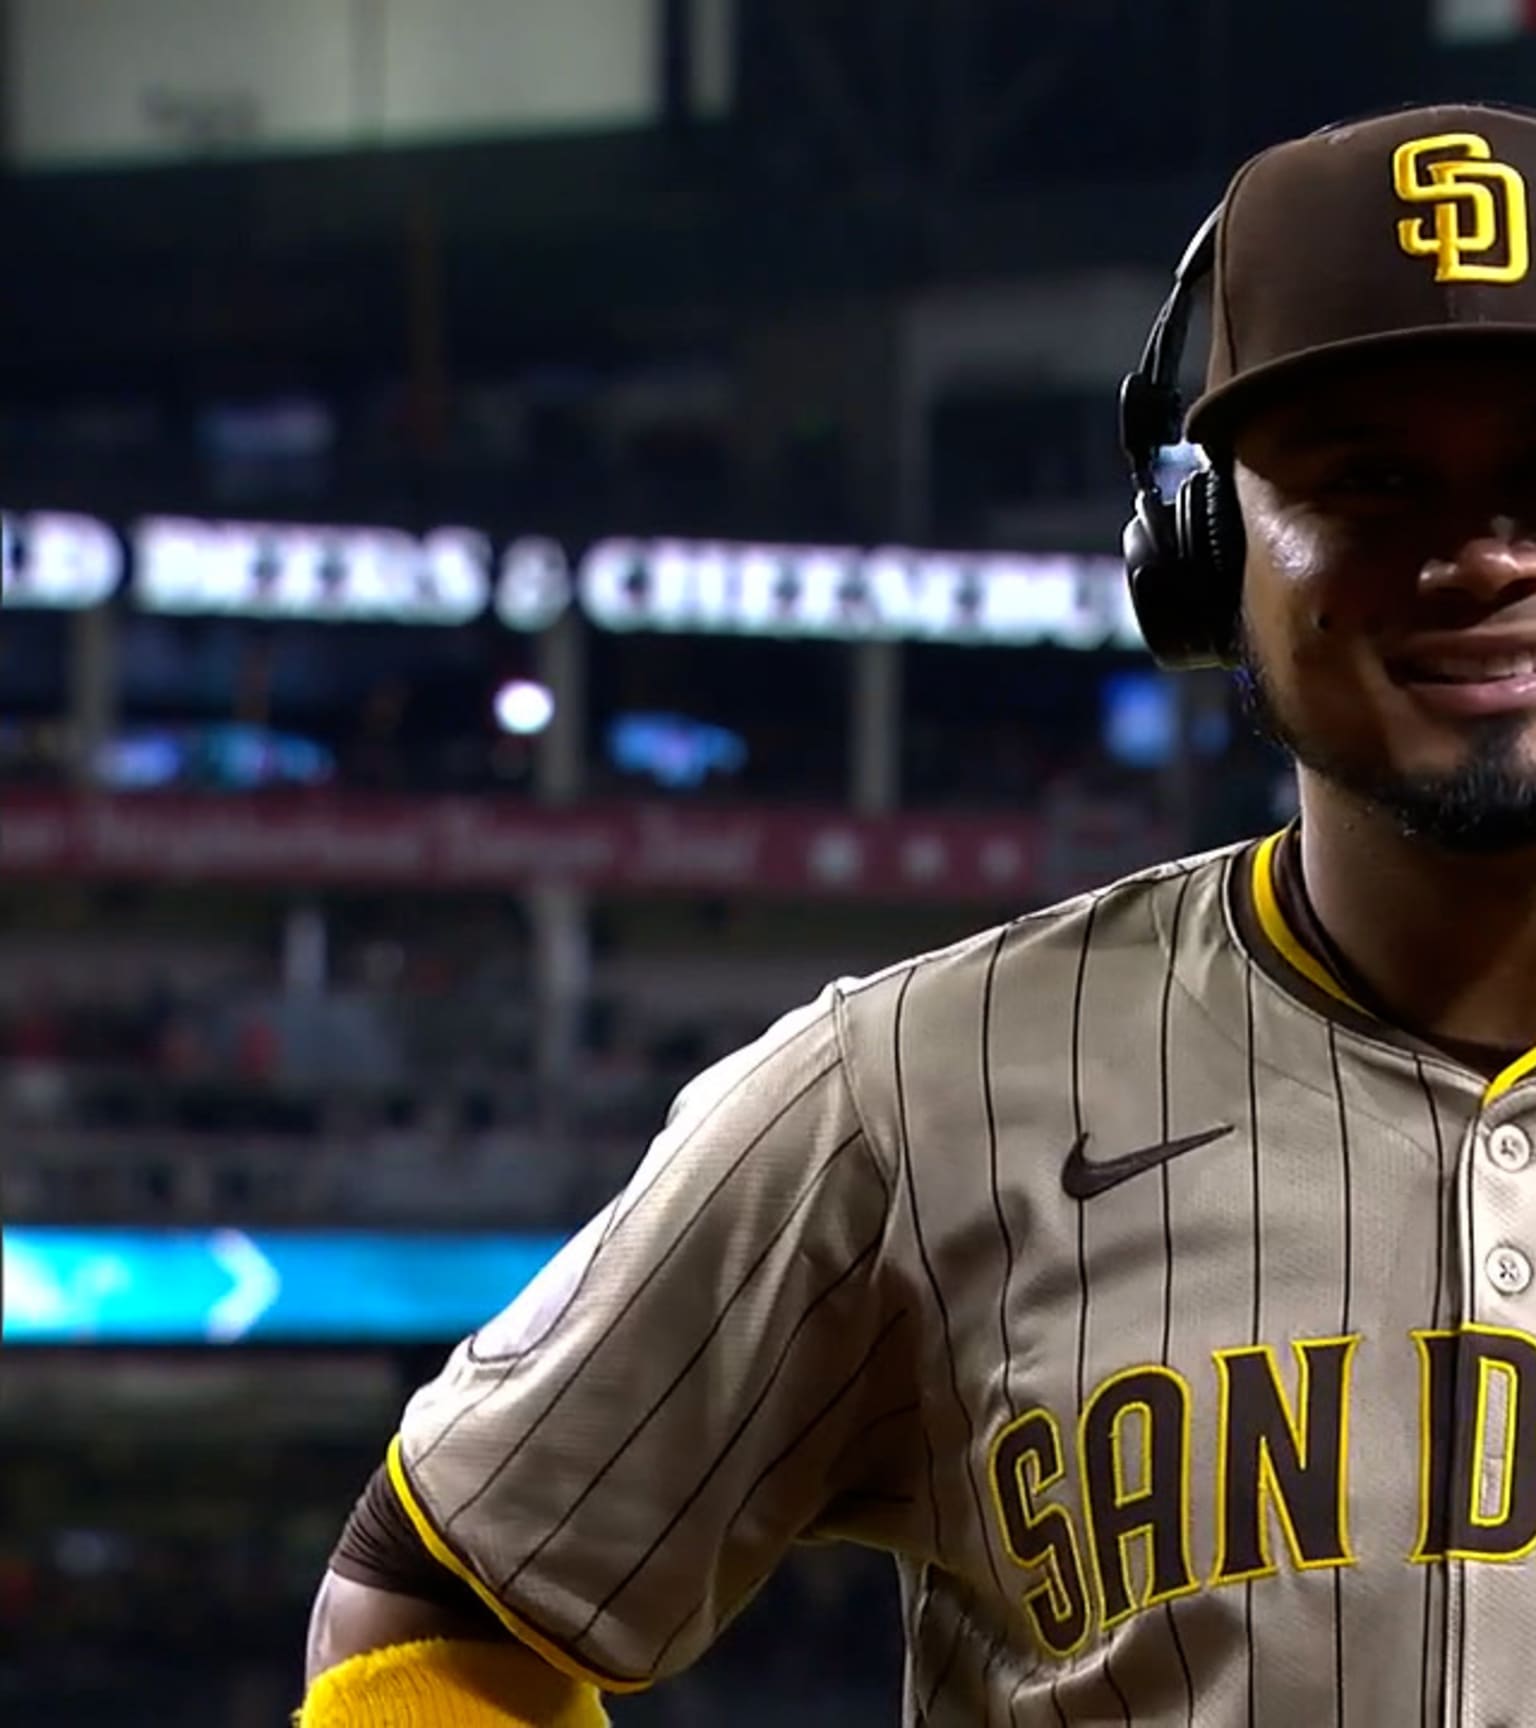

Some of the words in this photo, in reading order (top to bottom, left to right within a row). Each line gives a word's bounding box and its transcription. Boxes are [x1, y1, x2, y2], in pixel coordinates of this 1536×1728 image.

[1392, 131, 1530, 284] SD
[132, 514, 492, 628] BEERS
[989, 1332, 1364, 1657] SAN
